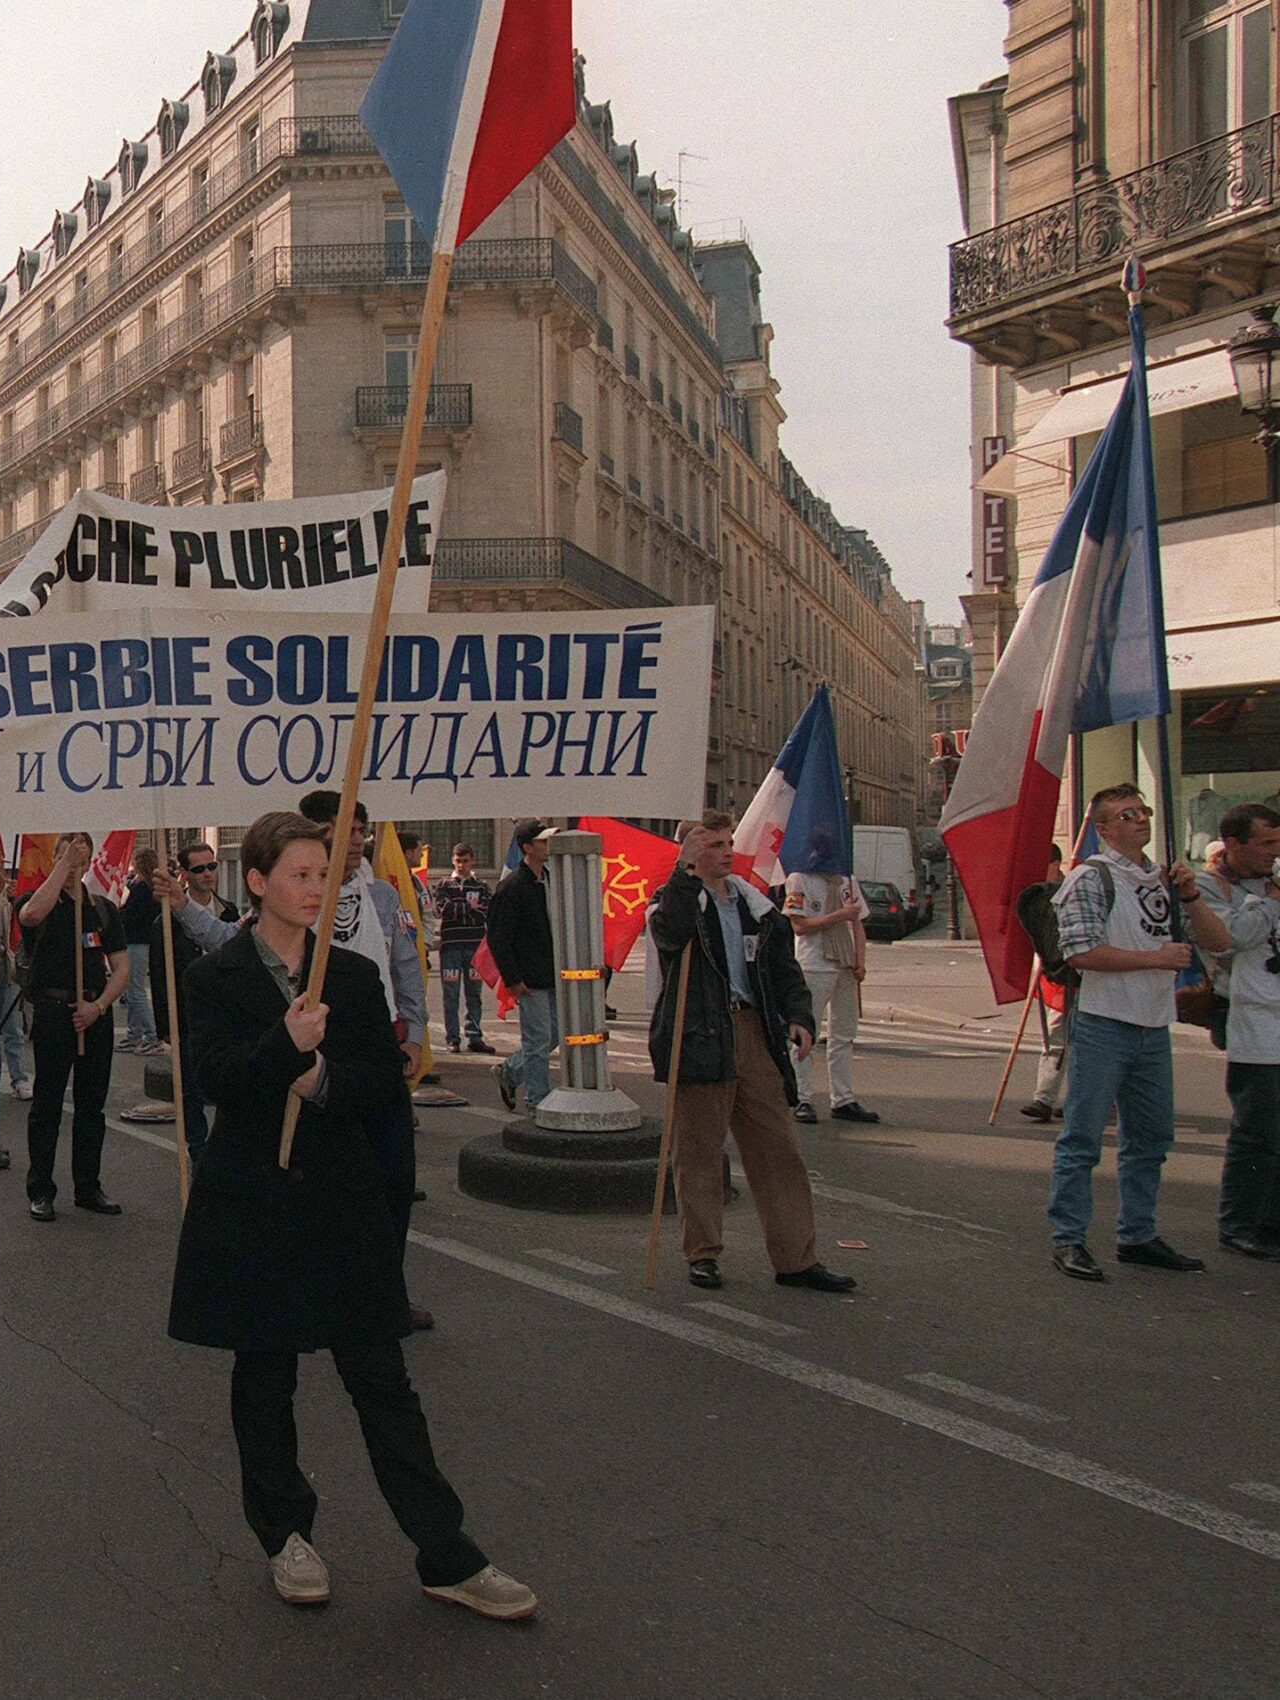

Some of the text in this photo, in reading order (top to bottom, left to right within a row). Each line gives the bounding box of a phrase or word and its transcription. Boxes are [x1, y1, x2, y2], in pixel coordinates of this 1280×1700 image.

[984, 438, 1005, 584] HTEL
[57, 717, 220, 793] СРБИ
[237, 711, 658, 795] СОЛИДАРНИ
